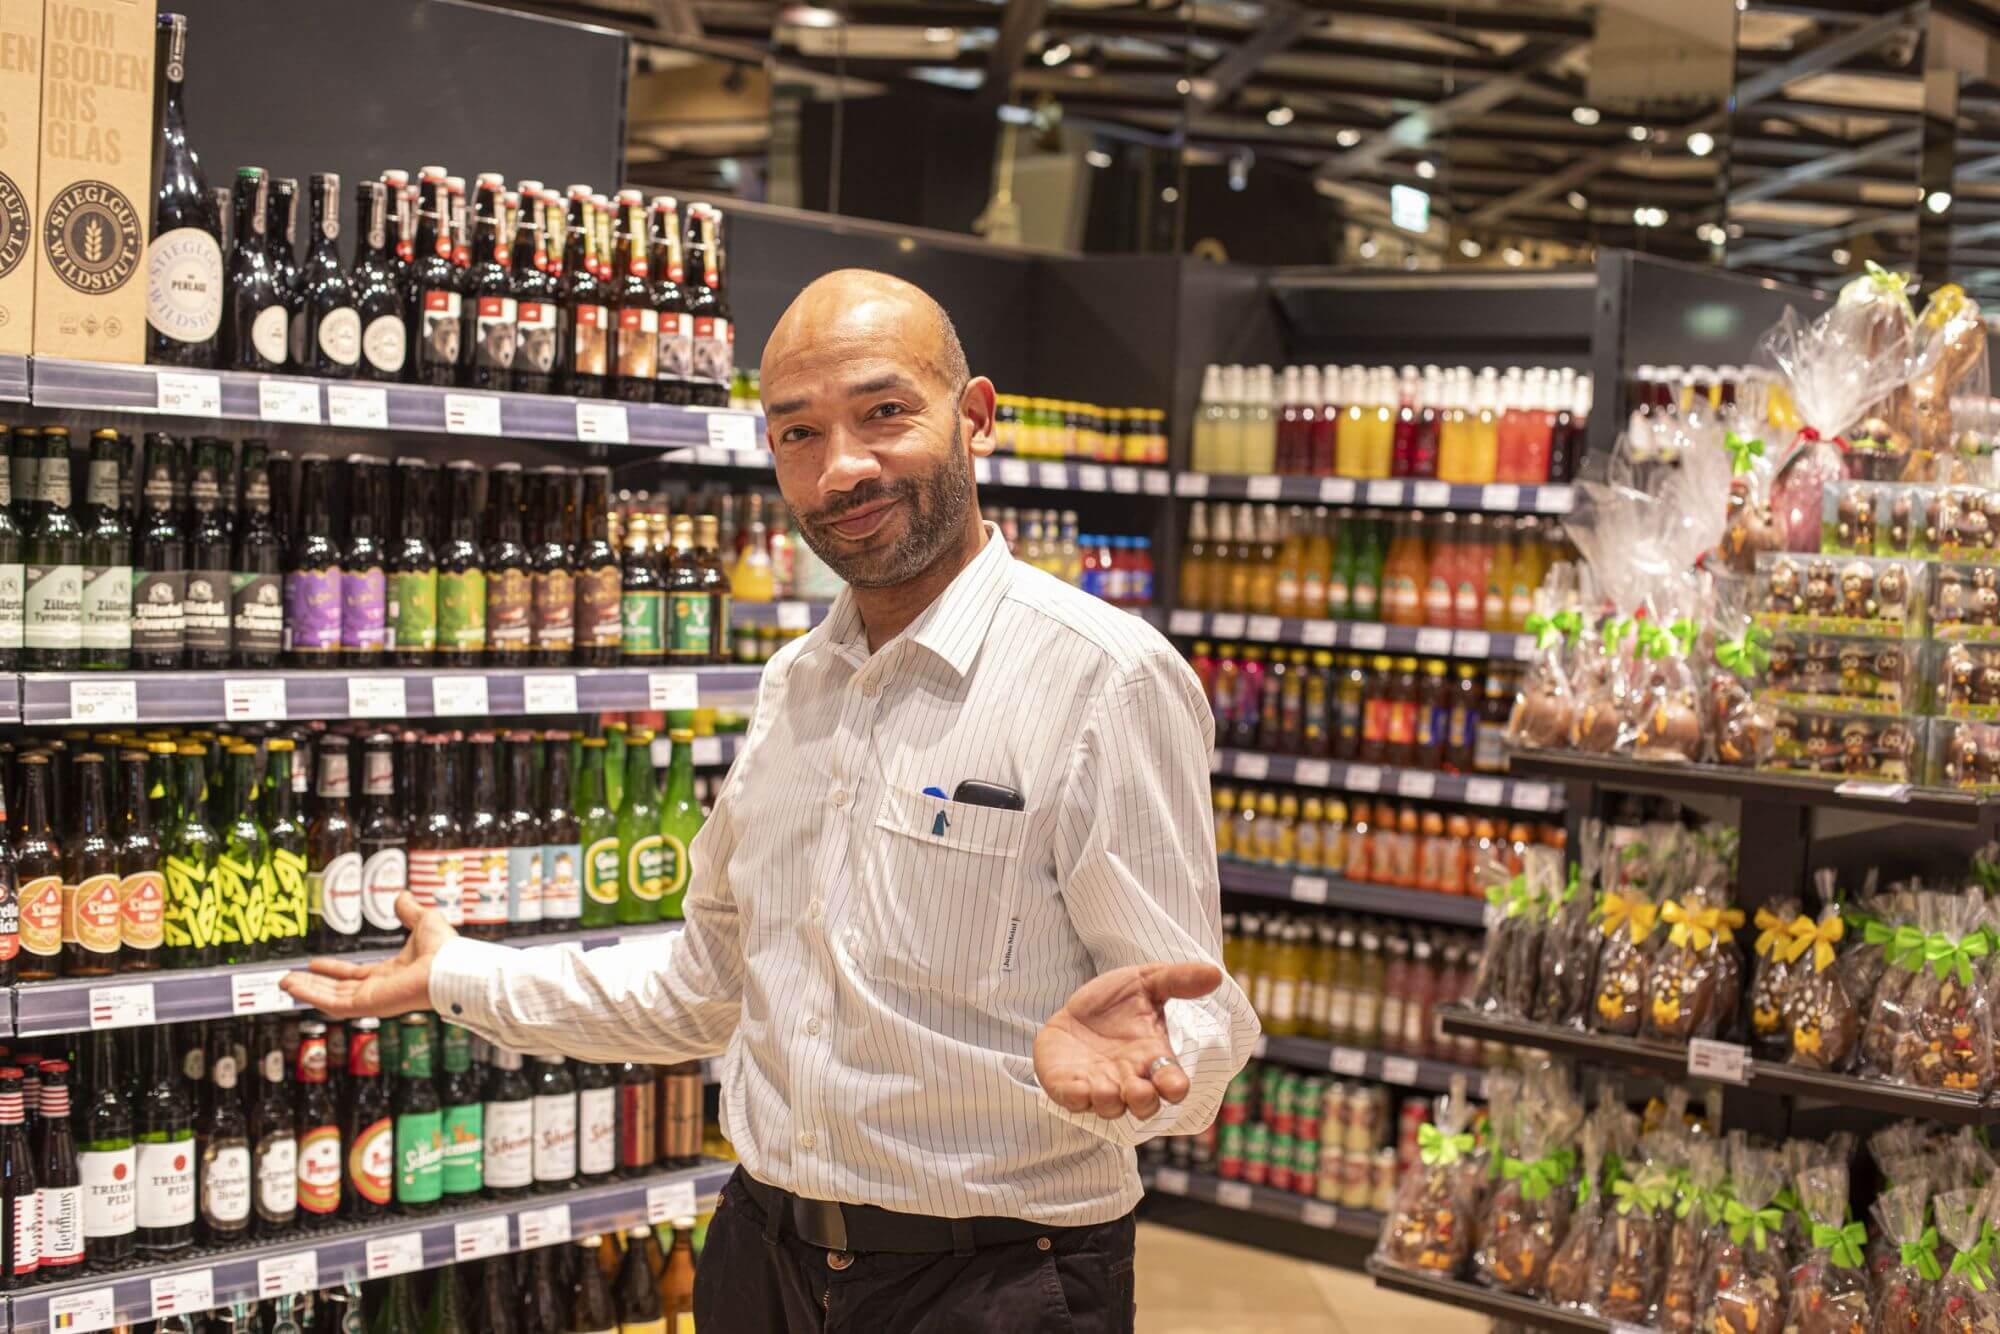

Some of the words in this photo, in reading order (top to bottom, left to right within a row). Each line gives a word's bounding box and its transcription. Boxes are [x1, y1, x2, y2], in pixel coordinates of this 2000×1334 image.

[51, 2, 114, 48] VOM
[48, 42, 148, 93] BODEN
[48, 80, 97, 122] INS
[47, 120, 121, 166] GLAS
[51, 186, 136, 235] STIEGLGUT
[50, 239, 136, 290] WILDSHUT
[1003, 945, 1012, 968] Julius
[1008, 922, 1017, 944] Meinl
